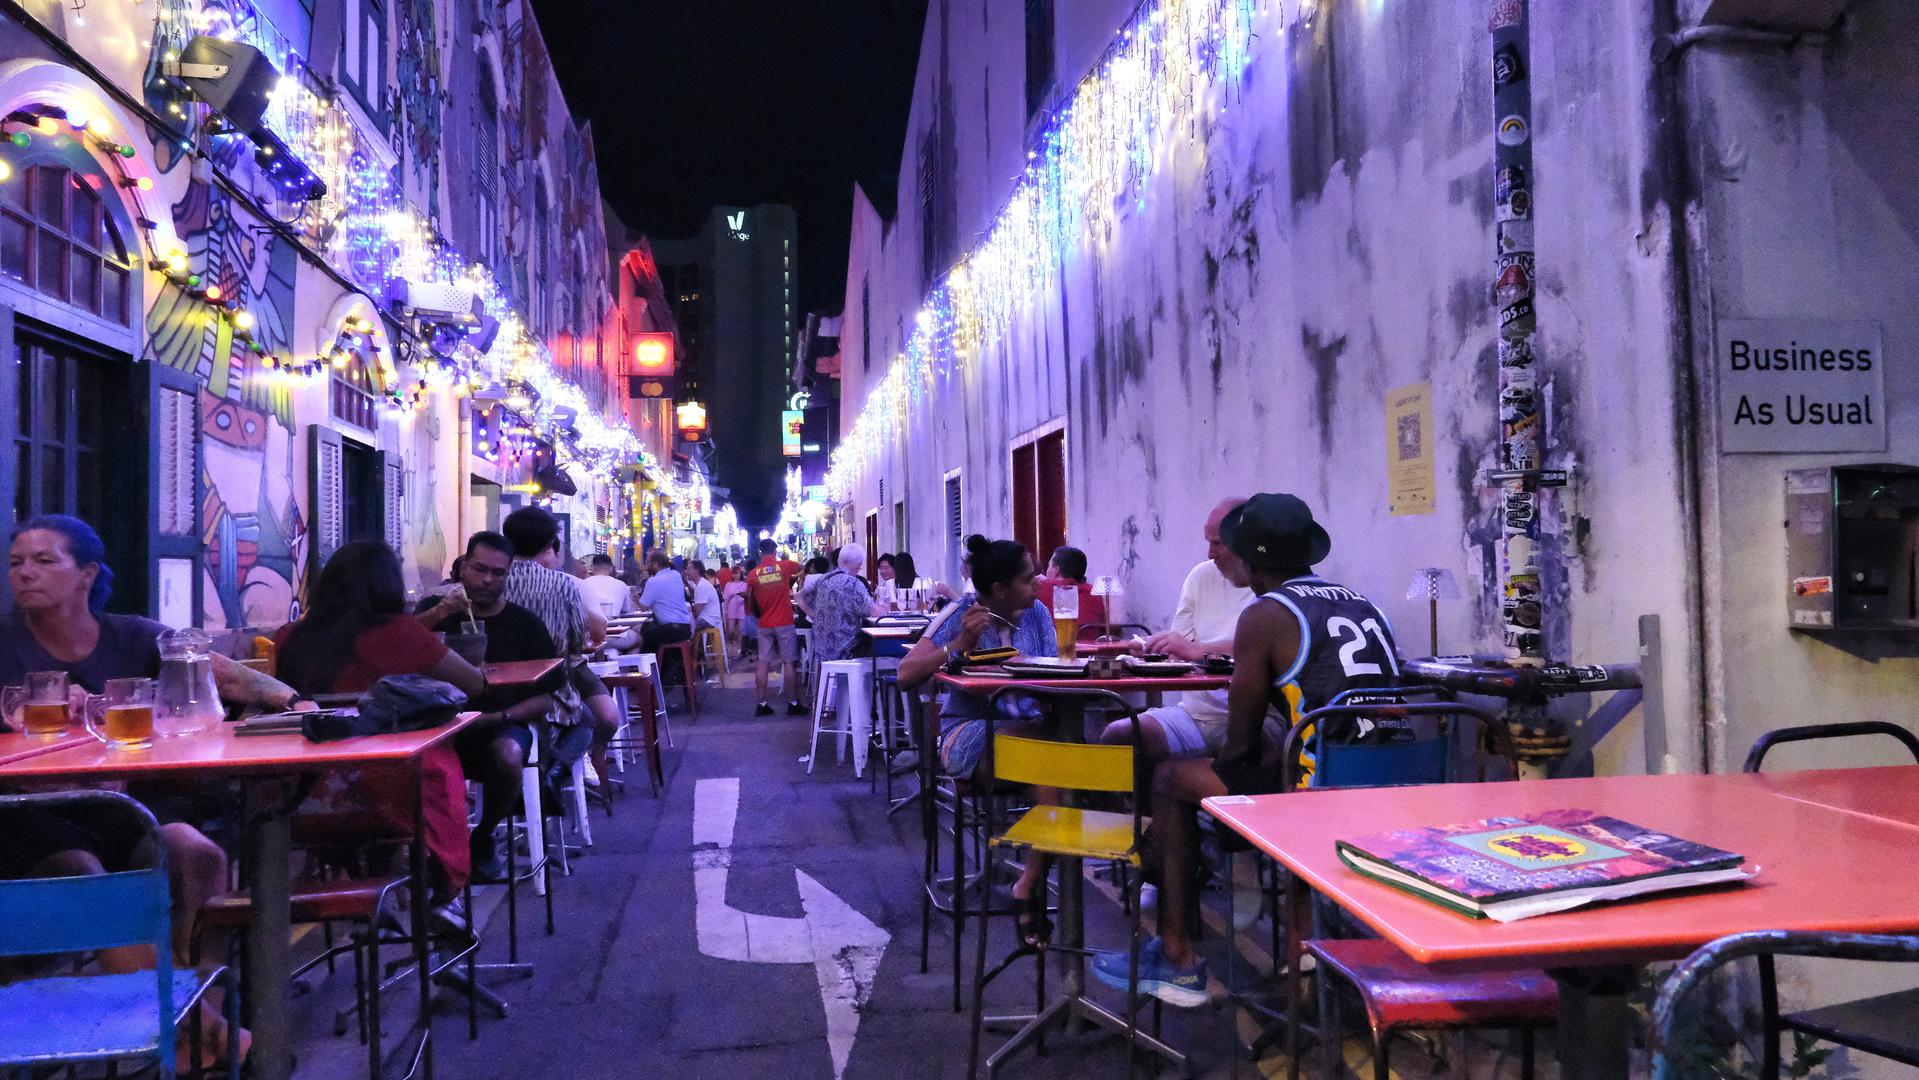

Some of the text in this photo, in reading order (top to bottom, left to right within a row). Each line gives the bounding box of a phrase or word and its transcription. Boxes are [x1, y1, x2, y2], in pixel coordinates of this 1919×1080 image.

[1730, 340, 1873, 372] Business
[1733, 394, 1873, 426] As Usual
[1326, 616, 1400, 678] 21
